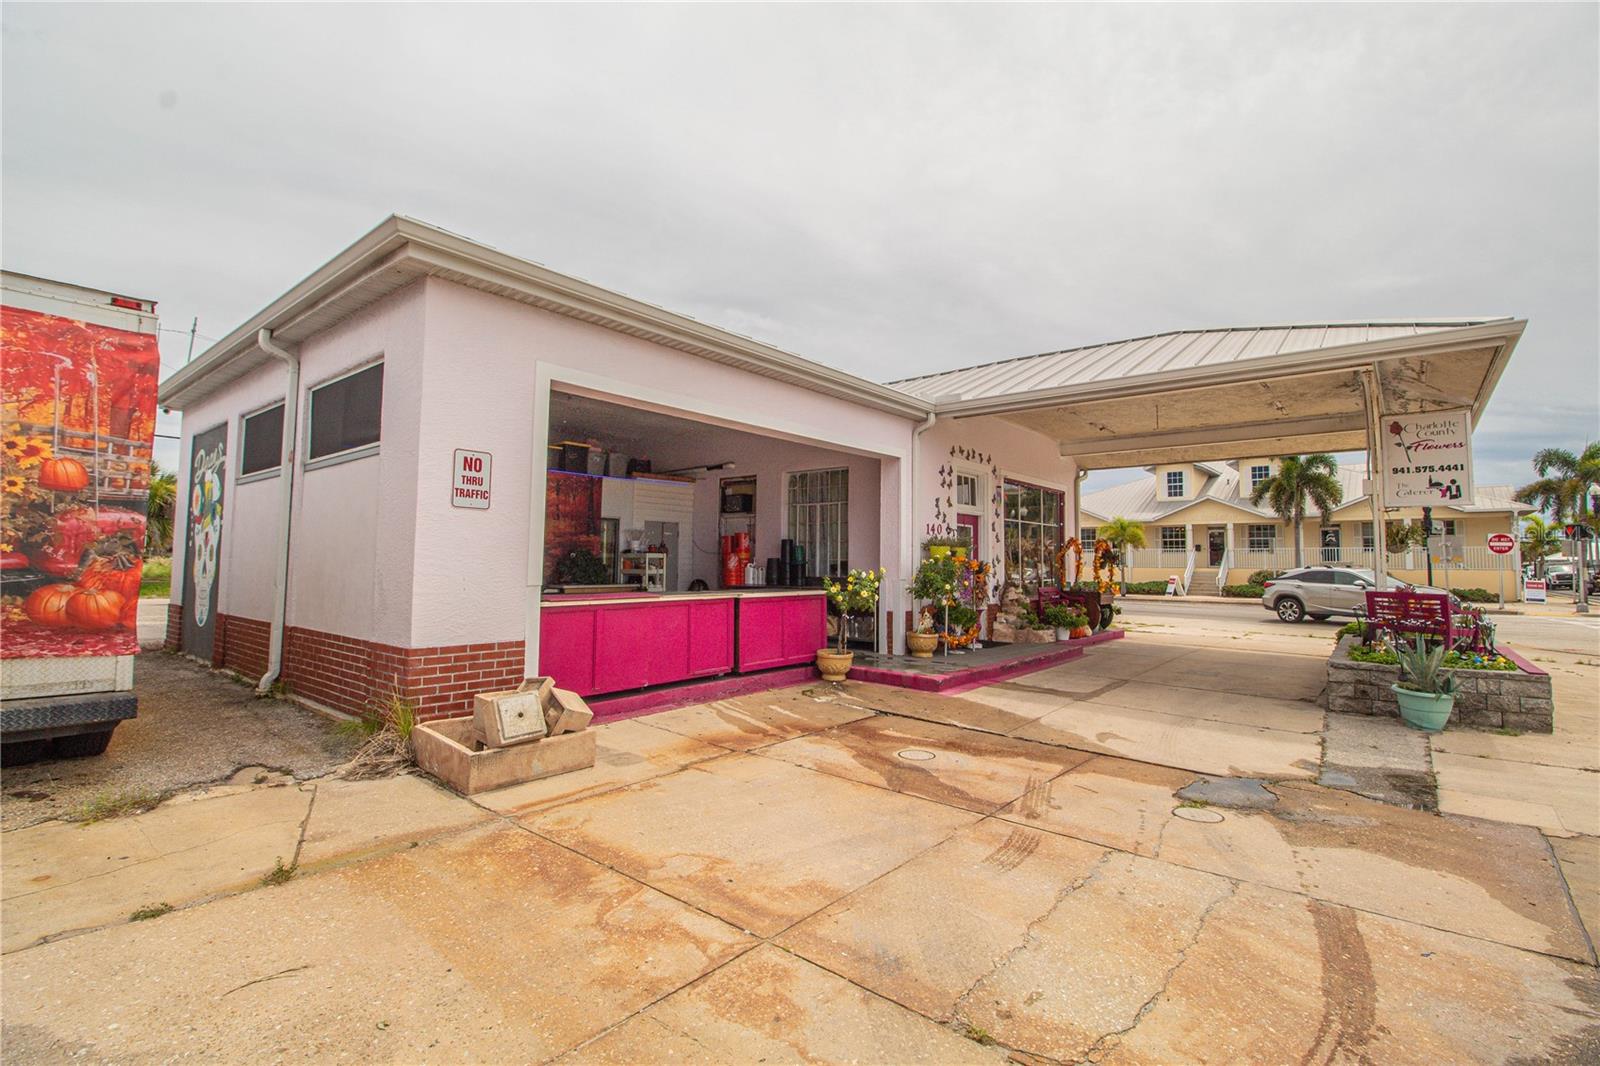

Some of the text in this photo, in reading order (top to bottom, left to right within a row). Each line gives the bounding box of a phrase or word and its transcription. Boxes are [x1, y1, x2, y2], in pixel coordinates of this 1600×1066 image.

[1403, 421, 1459, 433] Charlotte
[1416, 427, 1456, 438] County
[1410, 439, 1465, 453] Flowers
[463, 456, 482, 473] NO
[1392, 464, 1465, 475] 941.575.4441
[461, 475, 484, 487] THRU
[455, 488, 489, 500] TRAFFIC
[1396, 490, 1434, 498] Caterer
[926, 523, 942, 535] 140
